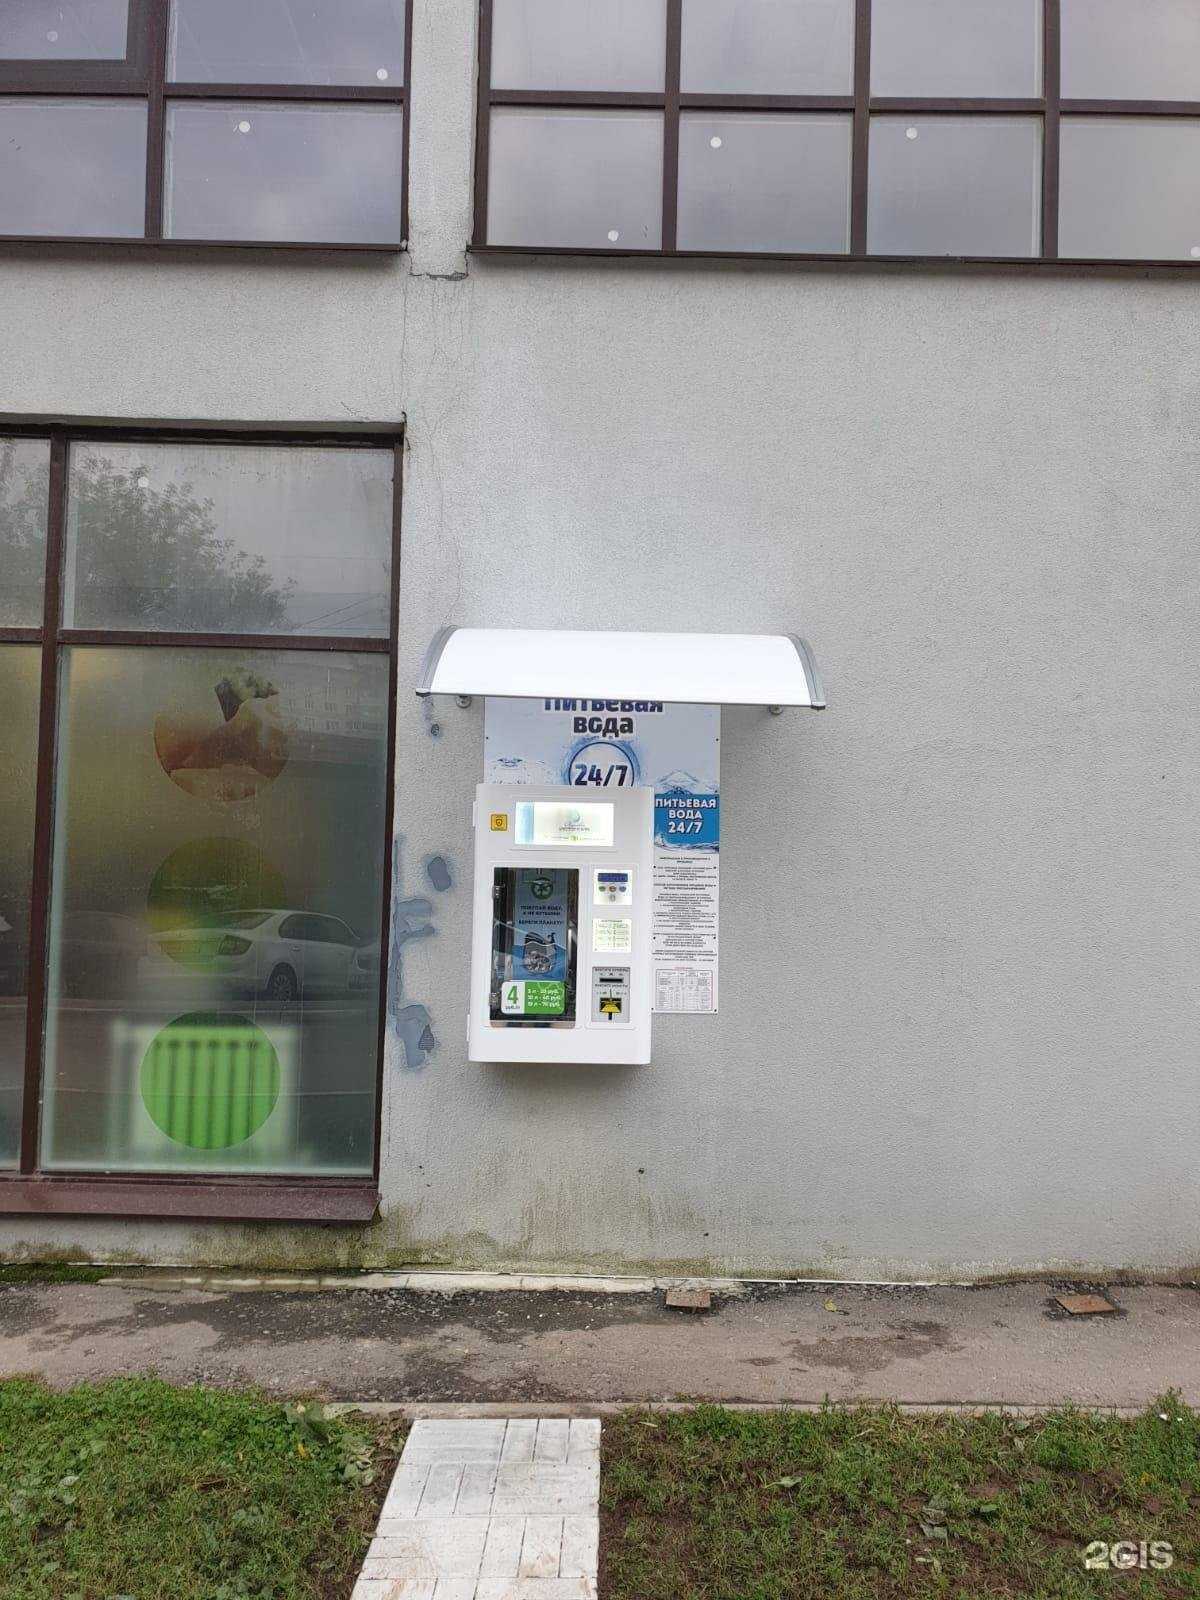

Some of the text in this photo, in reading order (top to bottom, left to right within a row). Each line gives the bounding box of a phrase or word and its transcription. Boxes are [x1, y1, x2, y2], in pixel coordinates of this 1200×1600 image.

[573, 716, 634, 738] вода
[574, 764, 628, 787] 24/7
[655, 798, 717, 809] ПИТЬЕВАЯ
[669, 809, 703, 820] ВОДА
[668, 821, 703, 834] 24/7
[507, 985, 519, 1004] 4
